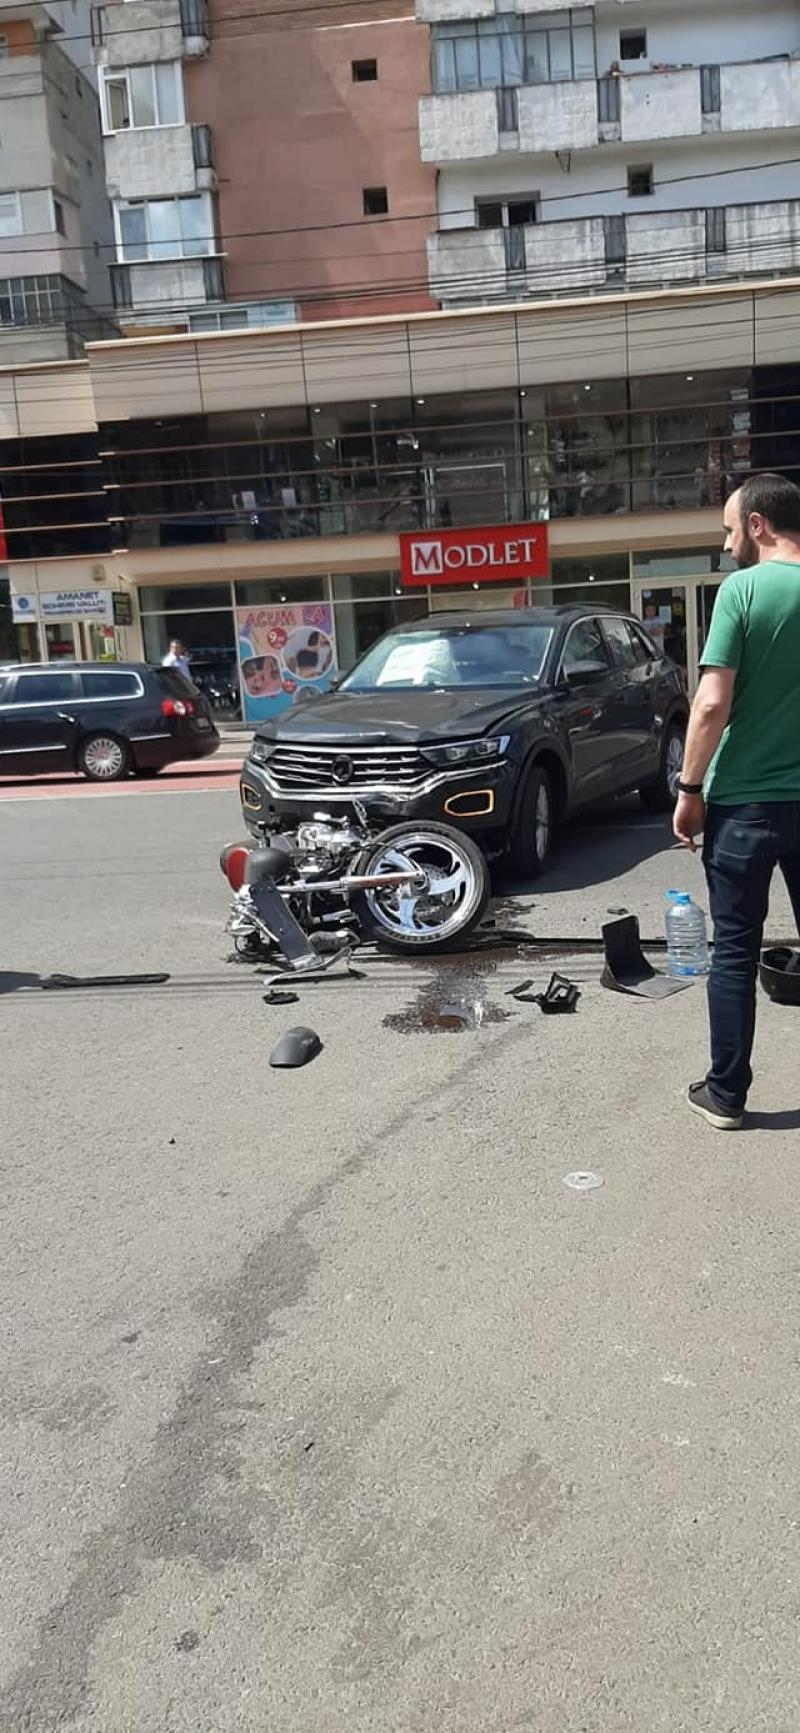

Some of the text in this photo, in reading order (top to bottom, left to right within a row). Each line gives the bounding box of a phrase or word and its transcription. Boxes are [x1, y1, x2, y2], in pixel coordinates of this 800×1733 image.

[411, 538, 537, 575] MODLET
[56, 591, 99, 601] AMANET
[246, 606, 326, 626] ACUM LA
